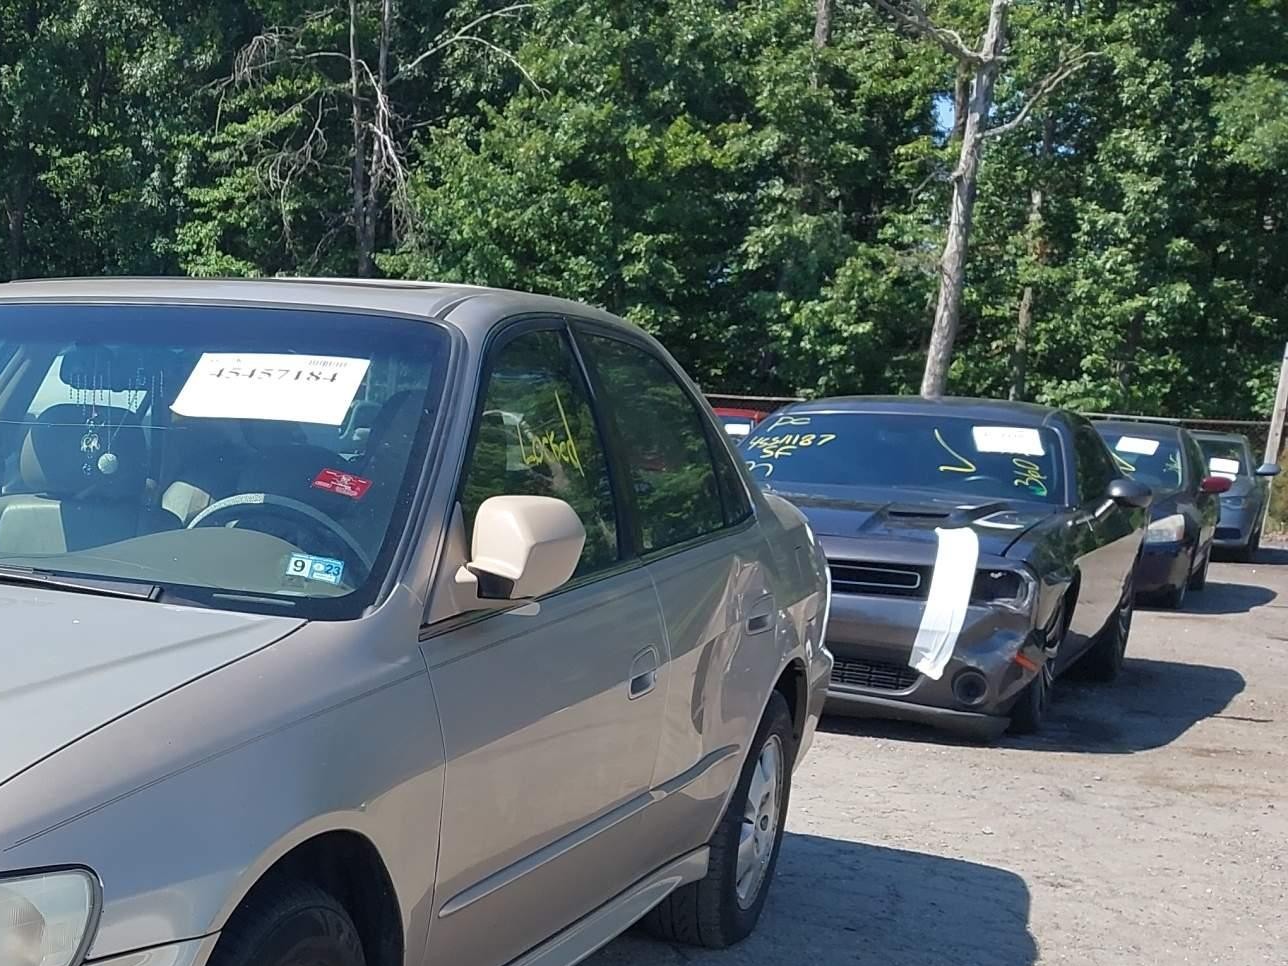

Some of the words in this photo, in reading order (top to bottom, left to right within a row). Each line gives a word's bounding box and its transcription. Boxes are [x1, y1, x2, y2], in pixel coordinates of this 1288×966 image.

[210, 367, 338, 383] 45457184
[293, 559, 306, 573] 9
[324, 564, 341, 576] 23
